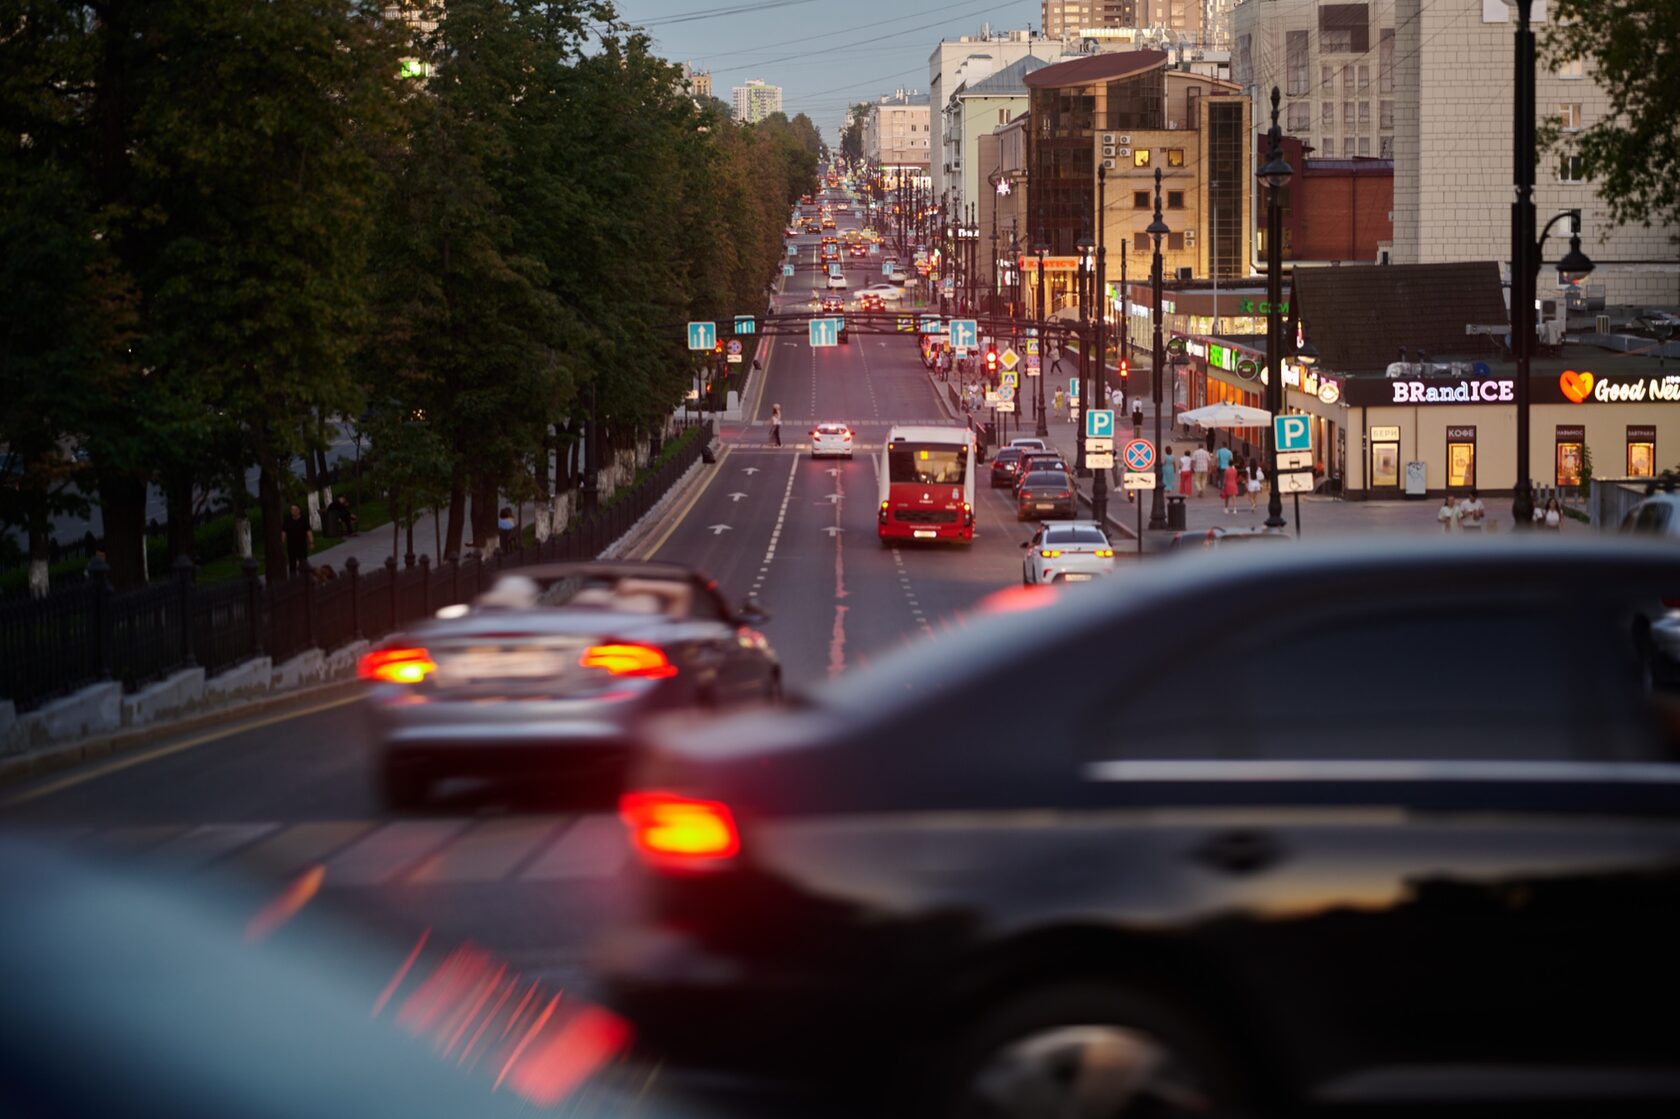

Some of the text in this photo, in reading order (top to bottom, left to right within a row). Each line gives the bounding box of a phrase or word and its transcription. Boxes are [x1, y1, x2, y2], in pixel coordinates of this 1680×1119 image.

[1594, 378, 1646, 403] Good
[1093, 412, 1110, 435] P
[1284, 418, 1305, 448] P
[1448, 428, 1475, 438] КОФЕ
